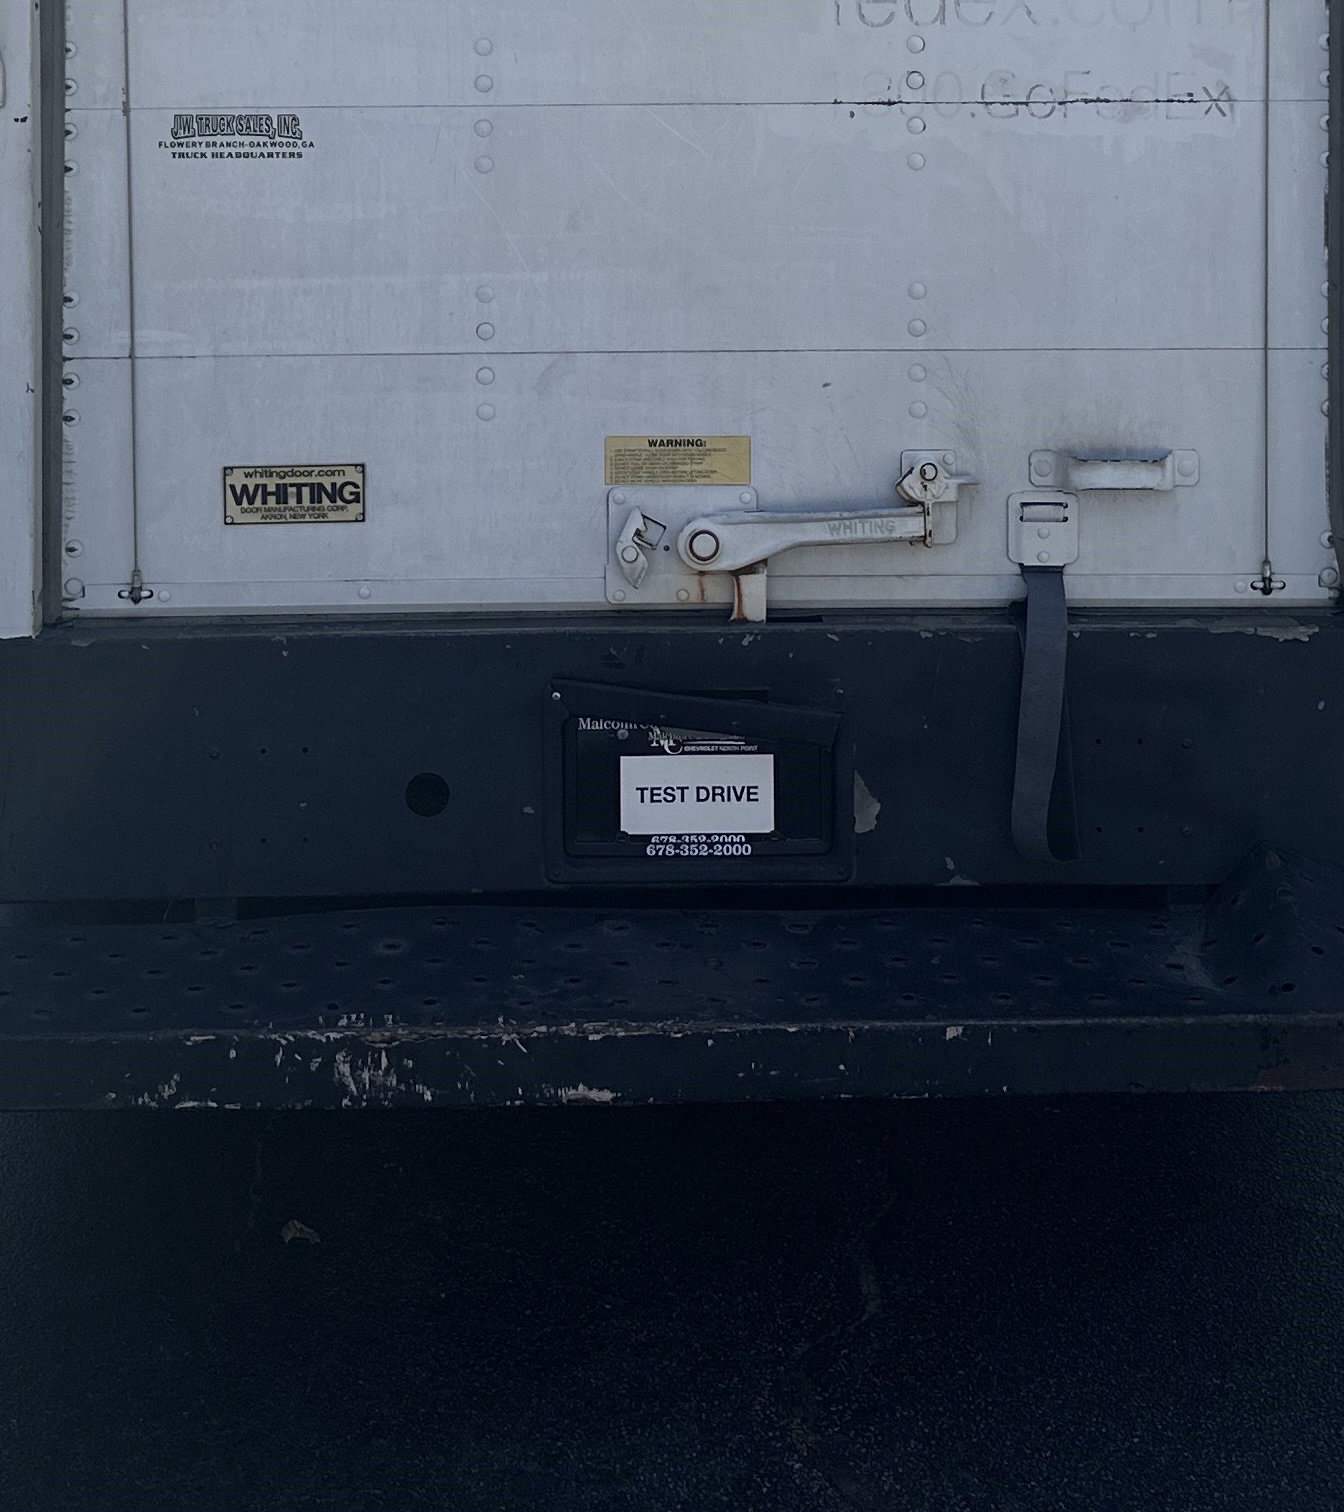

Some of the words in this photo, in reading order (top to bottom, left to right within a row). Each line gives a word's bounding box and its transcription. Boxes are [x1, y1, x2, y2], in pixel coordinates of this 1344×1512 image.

[196, 114, 236, 137] TRUCK
[277, 114, 303, 140] INC.
[158, 141, 203, 149] FLOWERY
[211, 151, 303, 159] HEADQUARTERS
[244, 468, 346, 479] whitingdoor.com
[229, 481, 361, 506] WHITING
[827, 519, 896, 537] WHITING
[636, 786, 689, 803] TEST
[696, 785, 759, 803] DRIVE
[646, 844, 752, 856] 678-352-2000
